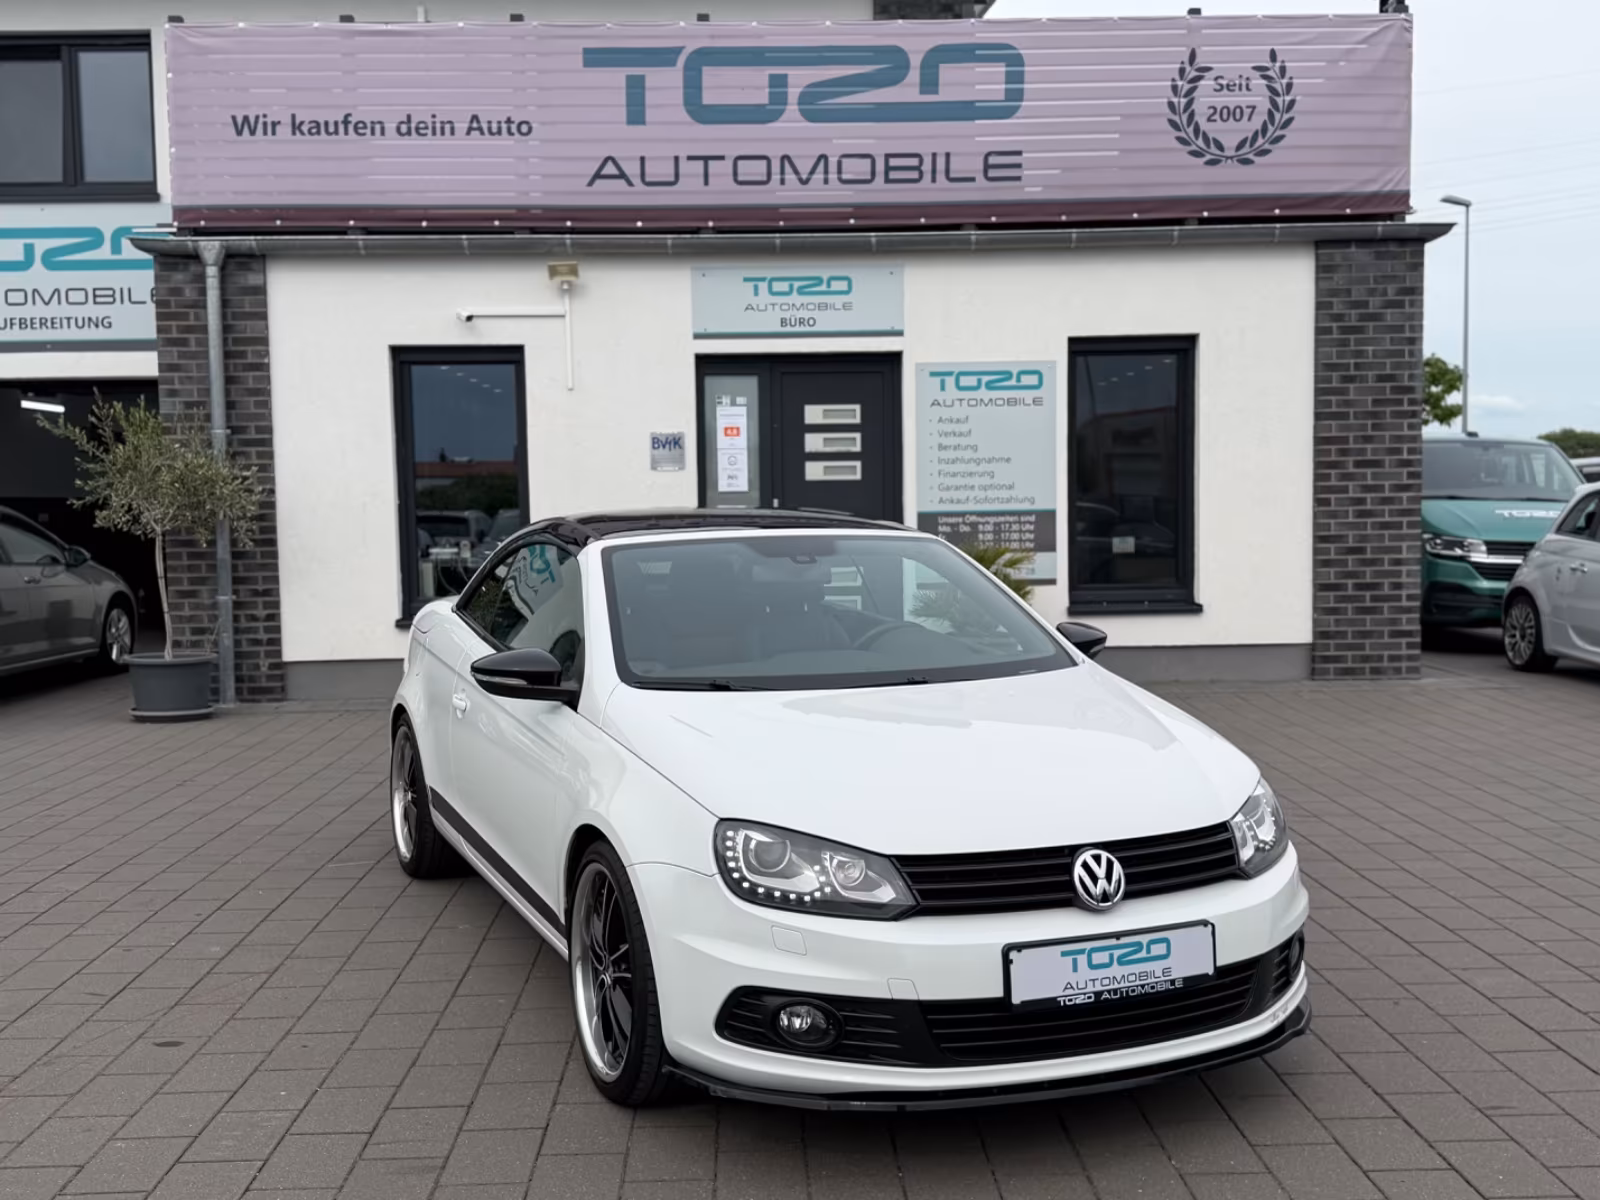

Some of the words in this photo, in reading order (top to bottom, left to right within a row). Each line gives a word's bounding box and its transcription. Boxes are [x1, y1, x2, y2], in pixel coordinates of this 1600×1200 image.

[583, 43, 1025, 126] TOZO
[1212, 75, 1253, 93] Seit
[1206, 105, 1257, 123] 2007
[231, 114, 282, 138] Wir
[291, 113, 386, 138] kaufen
[395, 113, 457, 138] dein
[465, 114, 534, 137] Auto
[586, 150, 1023, 188] AUTOMOBILE
[742, 275, 853, 297] TOZO
[743, 301, 854, 313] AUTOMOBILE
[779, 314, 817, 328] BÜRO
[929, 369, 1044, 392] TOZO
[929, 396, 1045, 408] AUTOMOBILE
[937, 415, 969, 425] Ankauf
[937, 429, 972, 439] Verkauf
[937, 442, 978, 454] Beratung
[937, 455, 1012, 466] Inzahlungnahme
[938, 469, 995, 480] Finanzierung
[938, 482, 976, 493] Garantie
[977, 481, 1015, 494] optional
[1060, 937, 1171, 973] TOZO
[1062, 967, 1172, 993] AUTOMOBILE
[1057, 993, 1094, 1006] TOZO
[1101, 978, 1184, 1000] AUTOMOBILE
